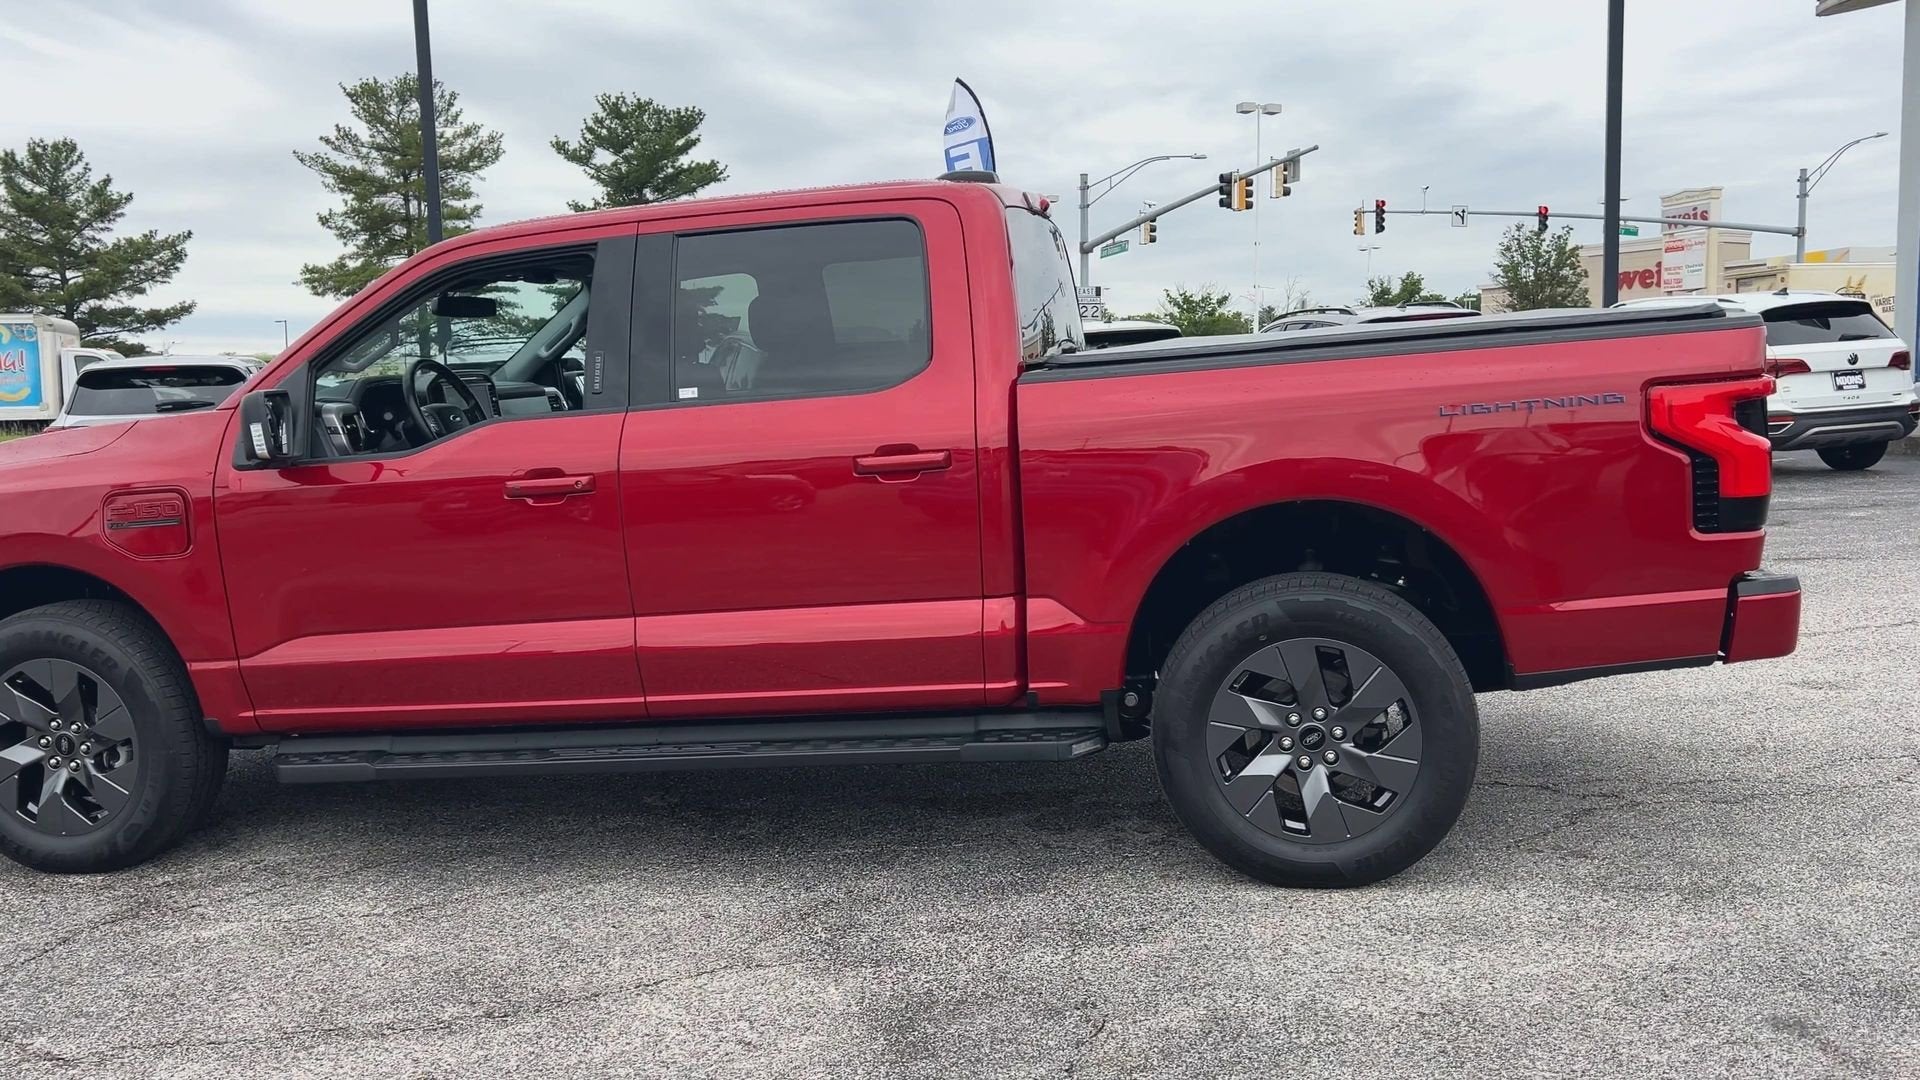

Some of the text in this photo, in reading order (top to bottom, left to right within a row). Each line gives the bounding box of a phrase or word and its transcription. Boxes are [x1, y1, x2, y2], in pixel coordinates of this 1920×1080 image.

[1835, 375, 1863, 386] KOONS
[1439, 392, 1625, 417] LIGHTNING
[106, 500, 182, 521] F-150
